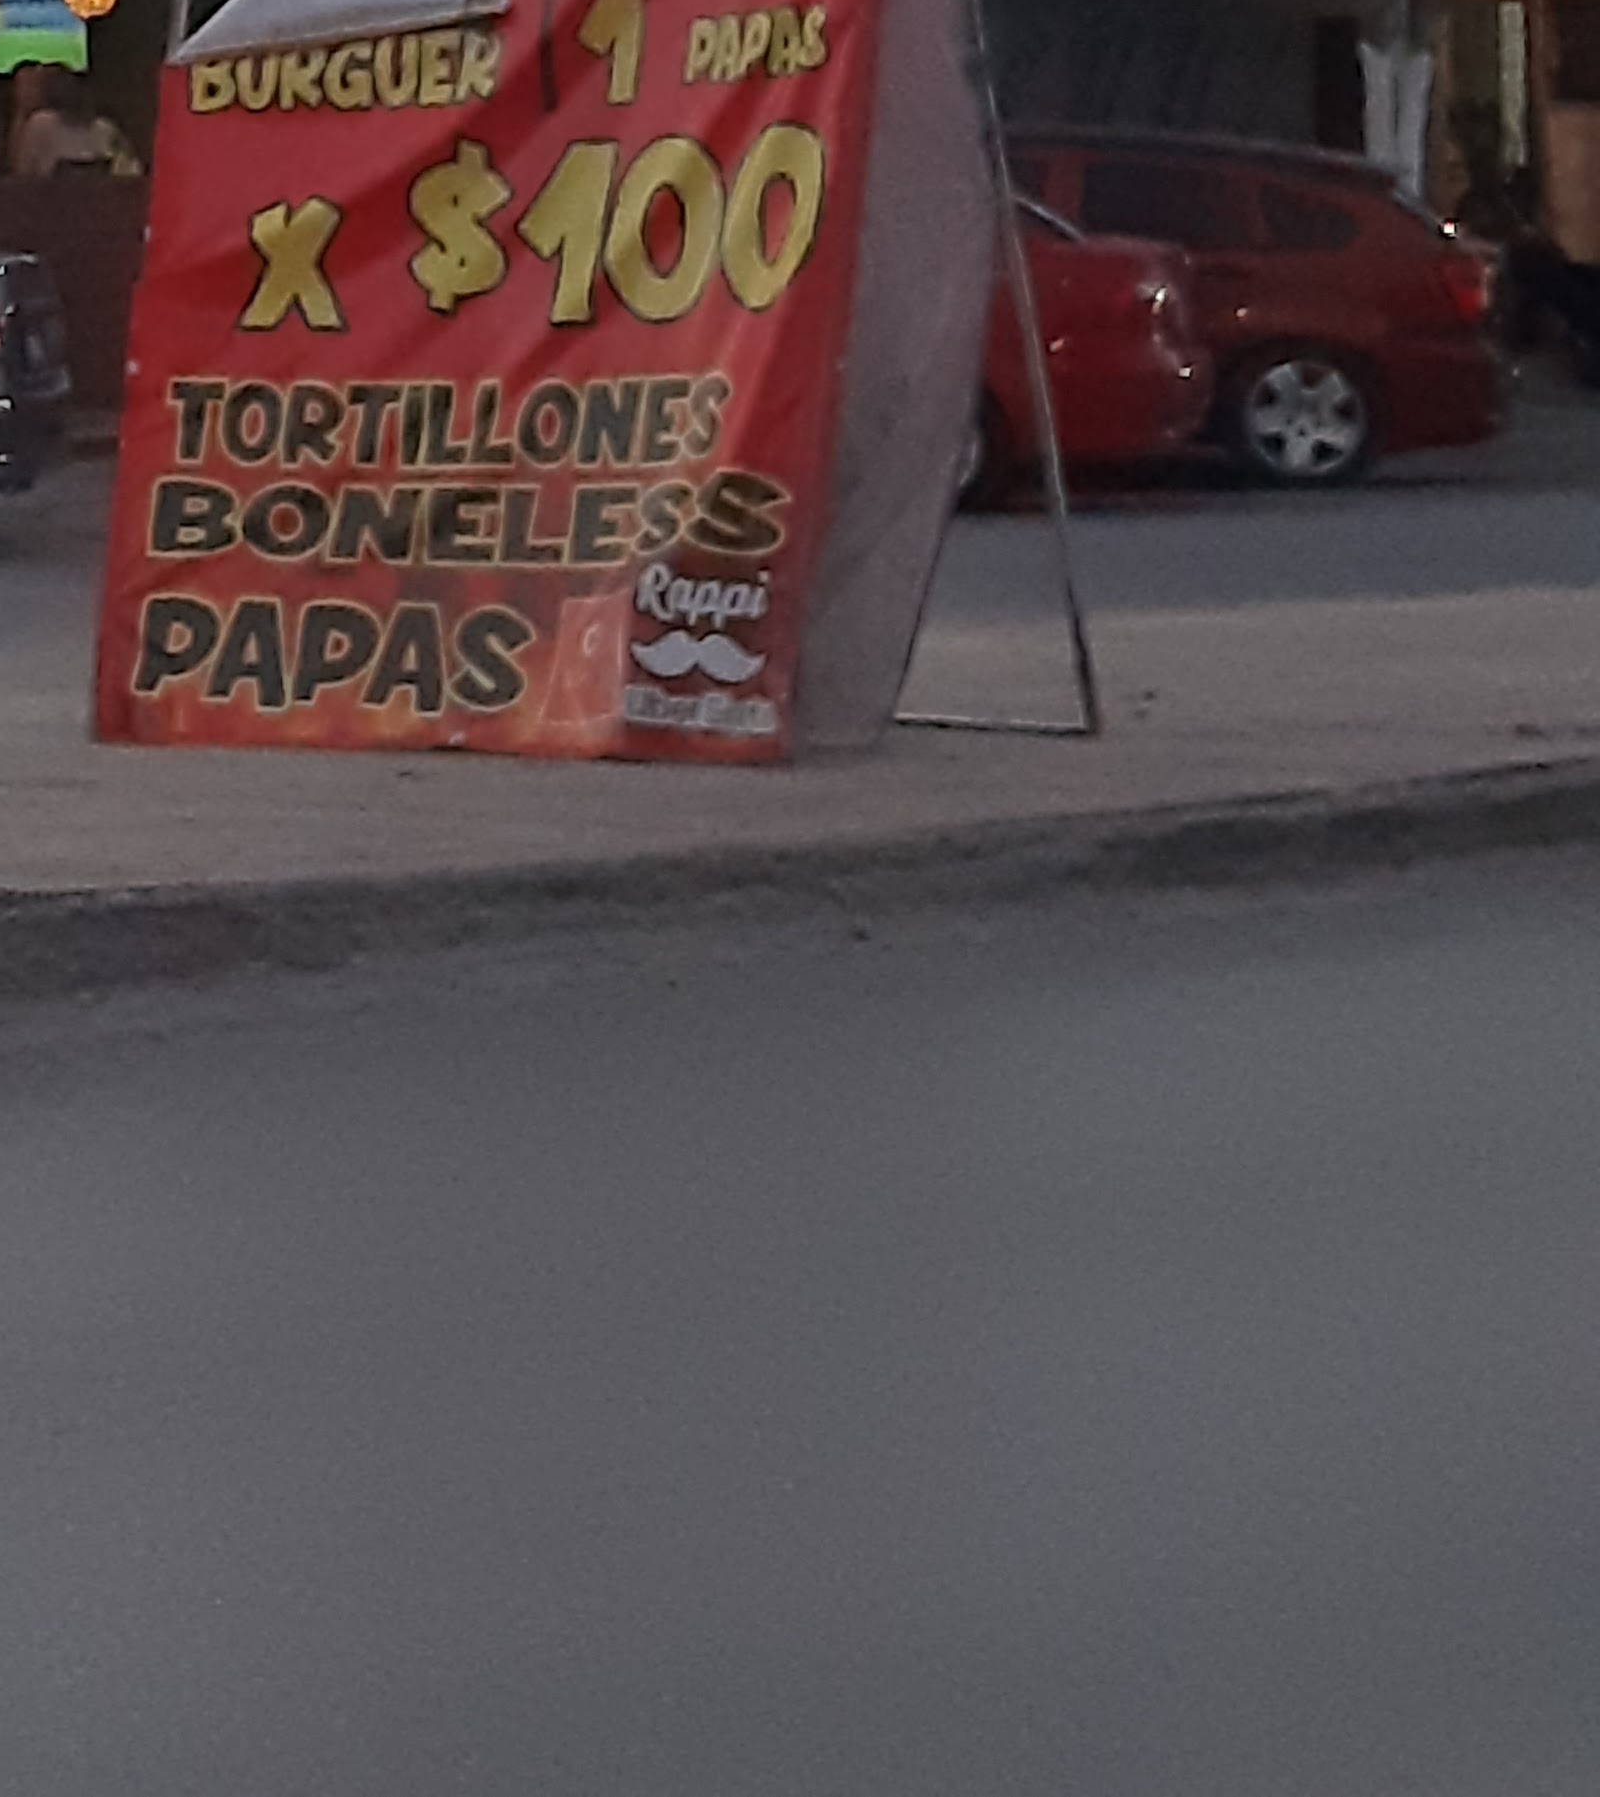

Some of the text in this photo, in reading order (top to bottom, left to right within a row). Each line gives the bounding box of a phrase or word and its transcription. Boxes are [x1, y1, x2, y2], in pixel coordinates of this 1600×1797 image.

[190, 26, 501, 114] BURGUER
[682, 5, 830, 86] PAPAS
[408, 121, 828, 325] $100
[169, 371, 732, 469] TORTILLONES
[145, 467, 793, 566] BONELESS
[635, 562, 771, 629] Rappi
[133, 592, 538, 718] PAPAS
